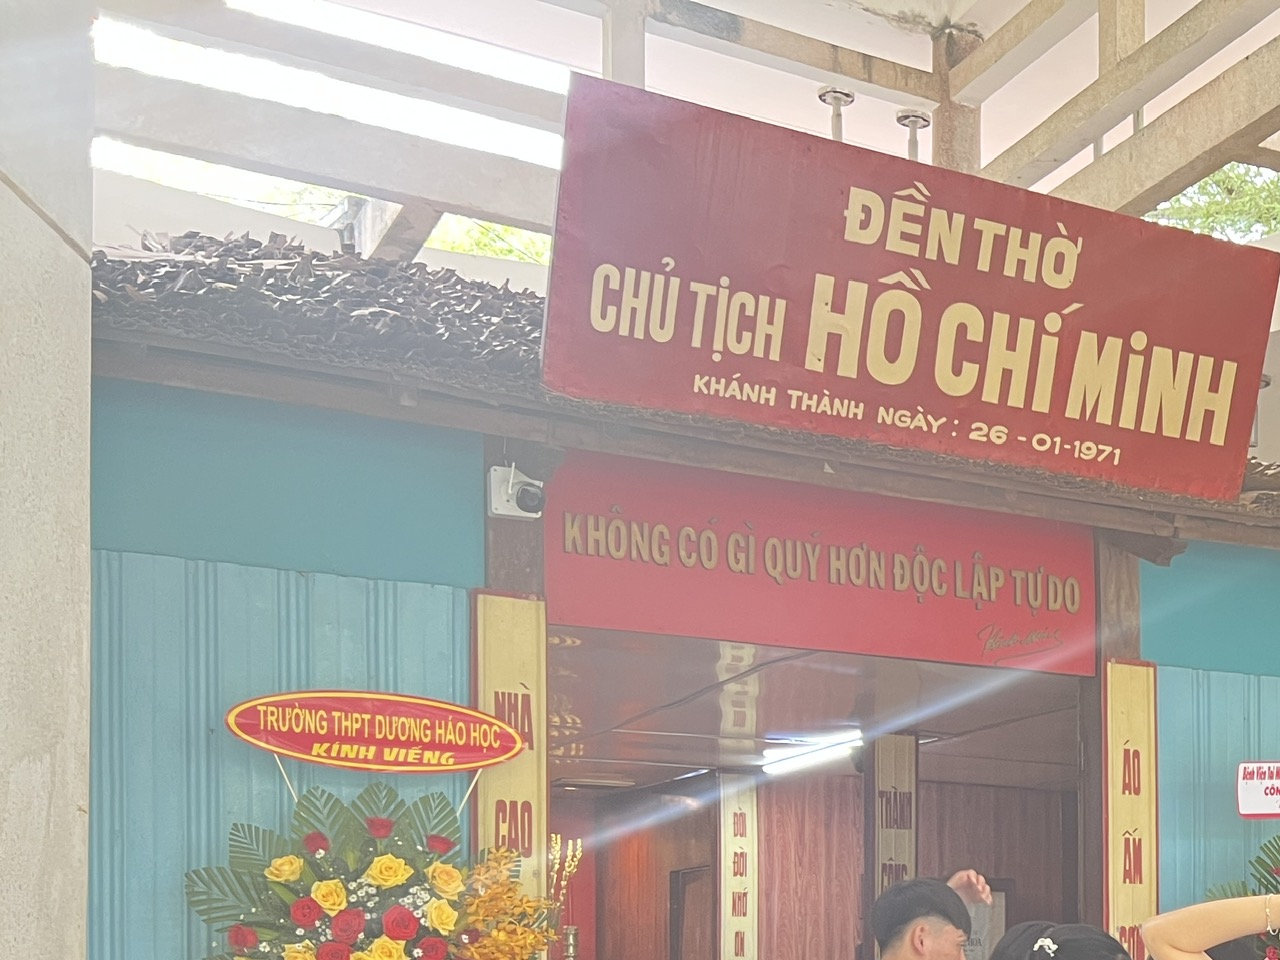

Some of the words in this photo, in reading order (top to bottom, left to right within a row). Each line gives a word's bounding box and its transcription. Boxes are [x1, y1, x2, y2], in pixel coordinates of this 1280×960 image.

[844, 181, 964, 265] ĐỀN
[973, 222, 1083, 290] THỜ
[590, 256, 680, 342] CHỦ
[690, 276, 786, 361] TỊCH
[804, 267, 932, 386] HỒ
[693, 373, 776, 406] KHÁNH
[787, 389, 865, 420] THÀNH
[969, 421, 1009, 446] 26
[564, 504, 671, 567] KHÔNG
[678, 517, 719, 571] CÓ
[727, 520, 756, 575] GÌ
[764, 531, 822, 586] QUÝ
[828, 543, 886, 590] HƠN
[893, 545, 948, 603] ĐỘC
[955, 551, 1005, 610] LẬP
[1011, 563, 1046, 616] TỰ
[1047, 575, 1080, 614] DO
[257, 702, 328, 735] TRƯỜNG
[332, 711, 371, 739] THPT
[375, 714, 432, 743] DƯƠNG
[469, 724, 501, 753] HỌC
[311, 741, 376, 760] KÍNH
[383, 745, 456, 766] VIẾNG
[1121, 740, 1142, 796] ÁO
[494, 800, 533, 858] CAO
[878, 785, 913, 830] THÀNH
[1121, 828, 1144, 885] ẤM
[734, 929, 745, 958] ƠN
